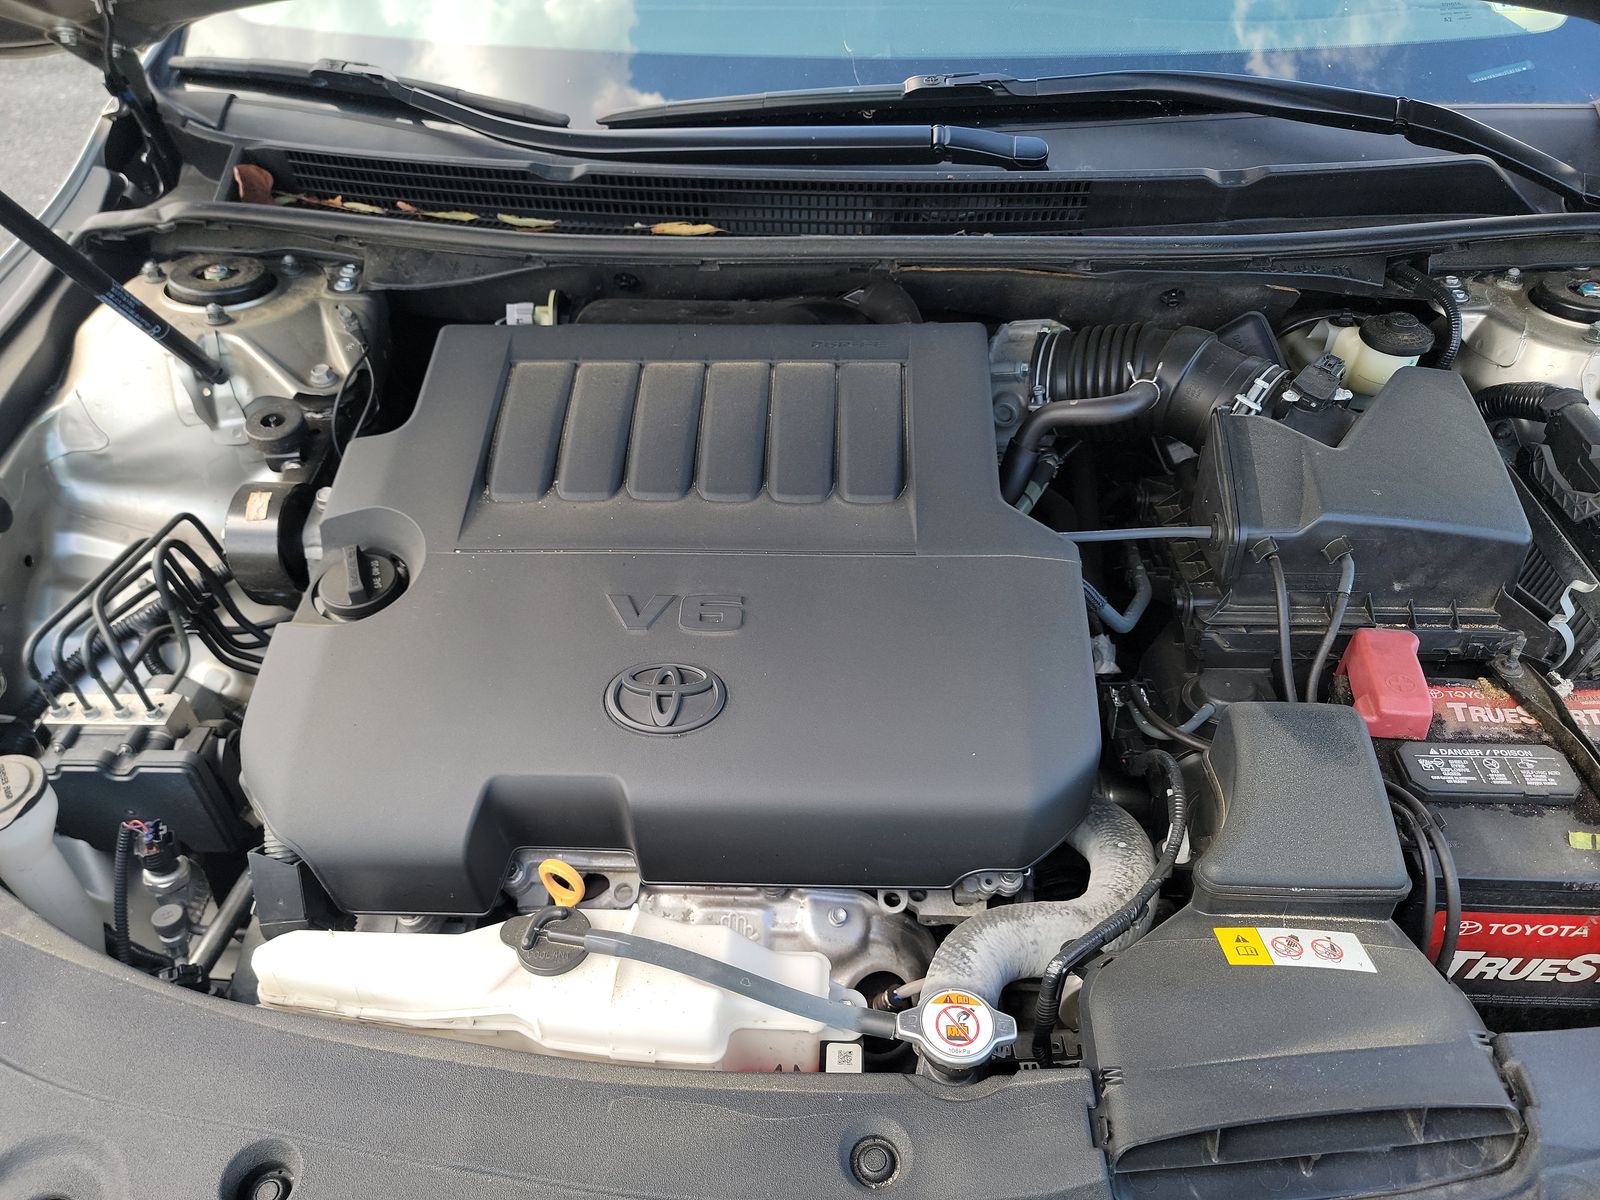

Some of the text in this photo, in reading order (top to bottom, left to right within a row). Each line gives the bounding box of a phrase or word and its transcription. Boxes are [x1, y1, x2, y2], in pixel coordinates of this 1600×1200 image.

[605, 593, 745, 635] V6
[1445, 690, 1487, 699] TOYO
[1439, 748, 1483, 756] DANGER
[1492, 749, 1533, 757] POISON
[1488, 923, 1589, 938] TOYOTA
[1446, 950, 1600, 983] TRUES
